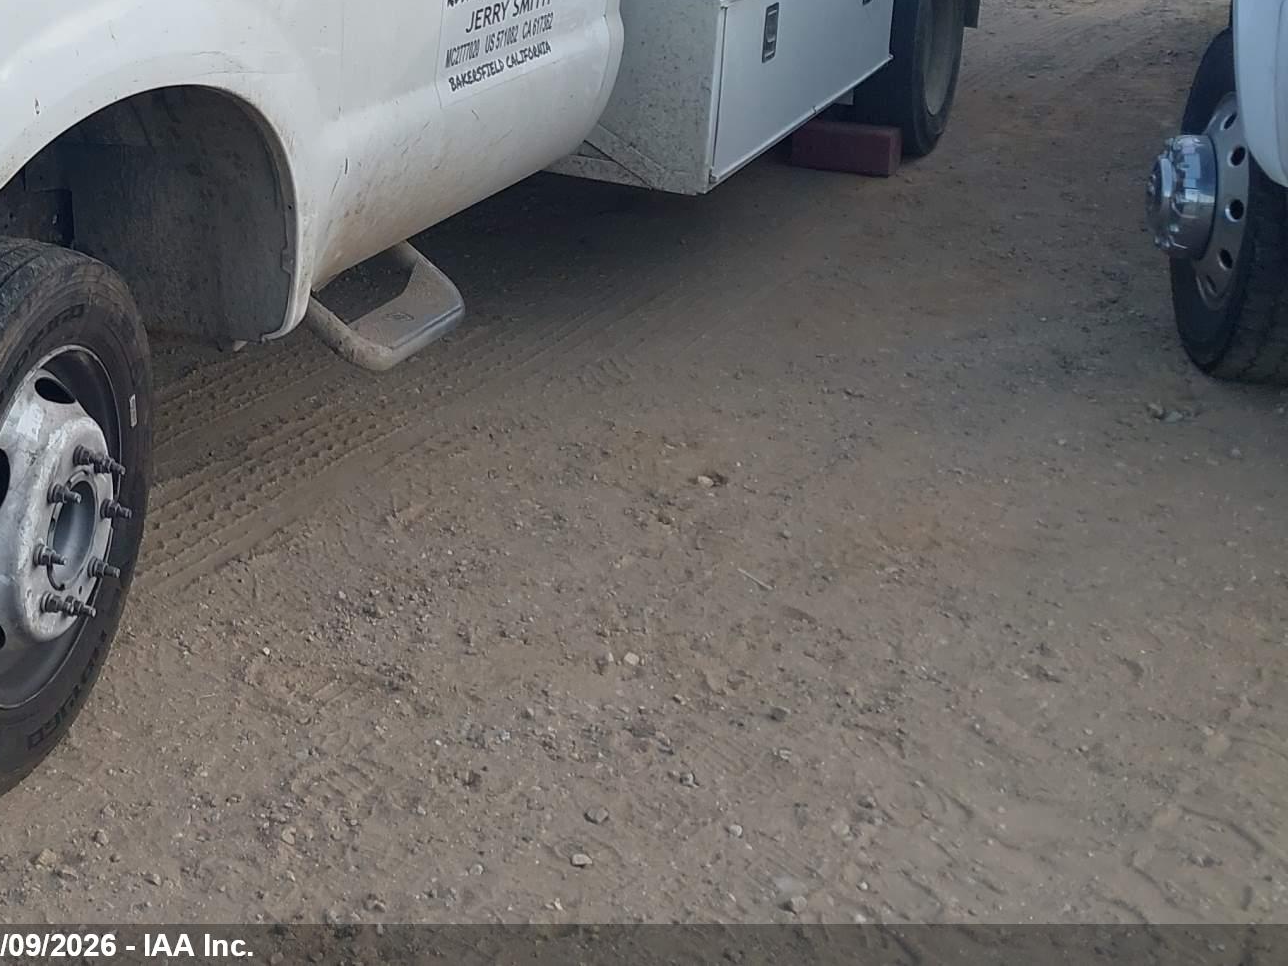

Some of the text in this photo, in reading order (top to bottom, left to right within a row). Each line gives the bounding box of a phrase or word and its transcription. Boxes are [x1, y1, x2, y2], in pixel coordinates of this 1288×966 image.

[465, 0, 510, 33] JERRY
[448, 40, 552, 92] BAKERSFIELD CALIFORNIA
